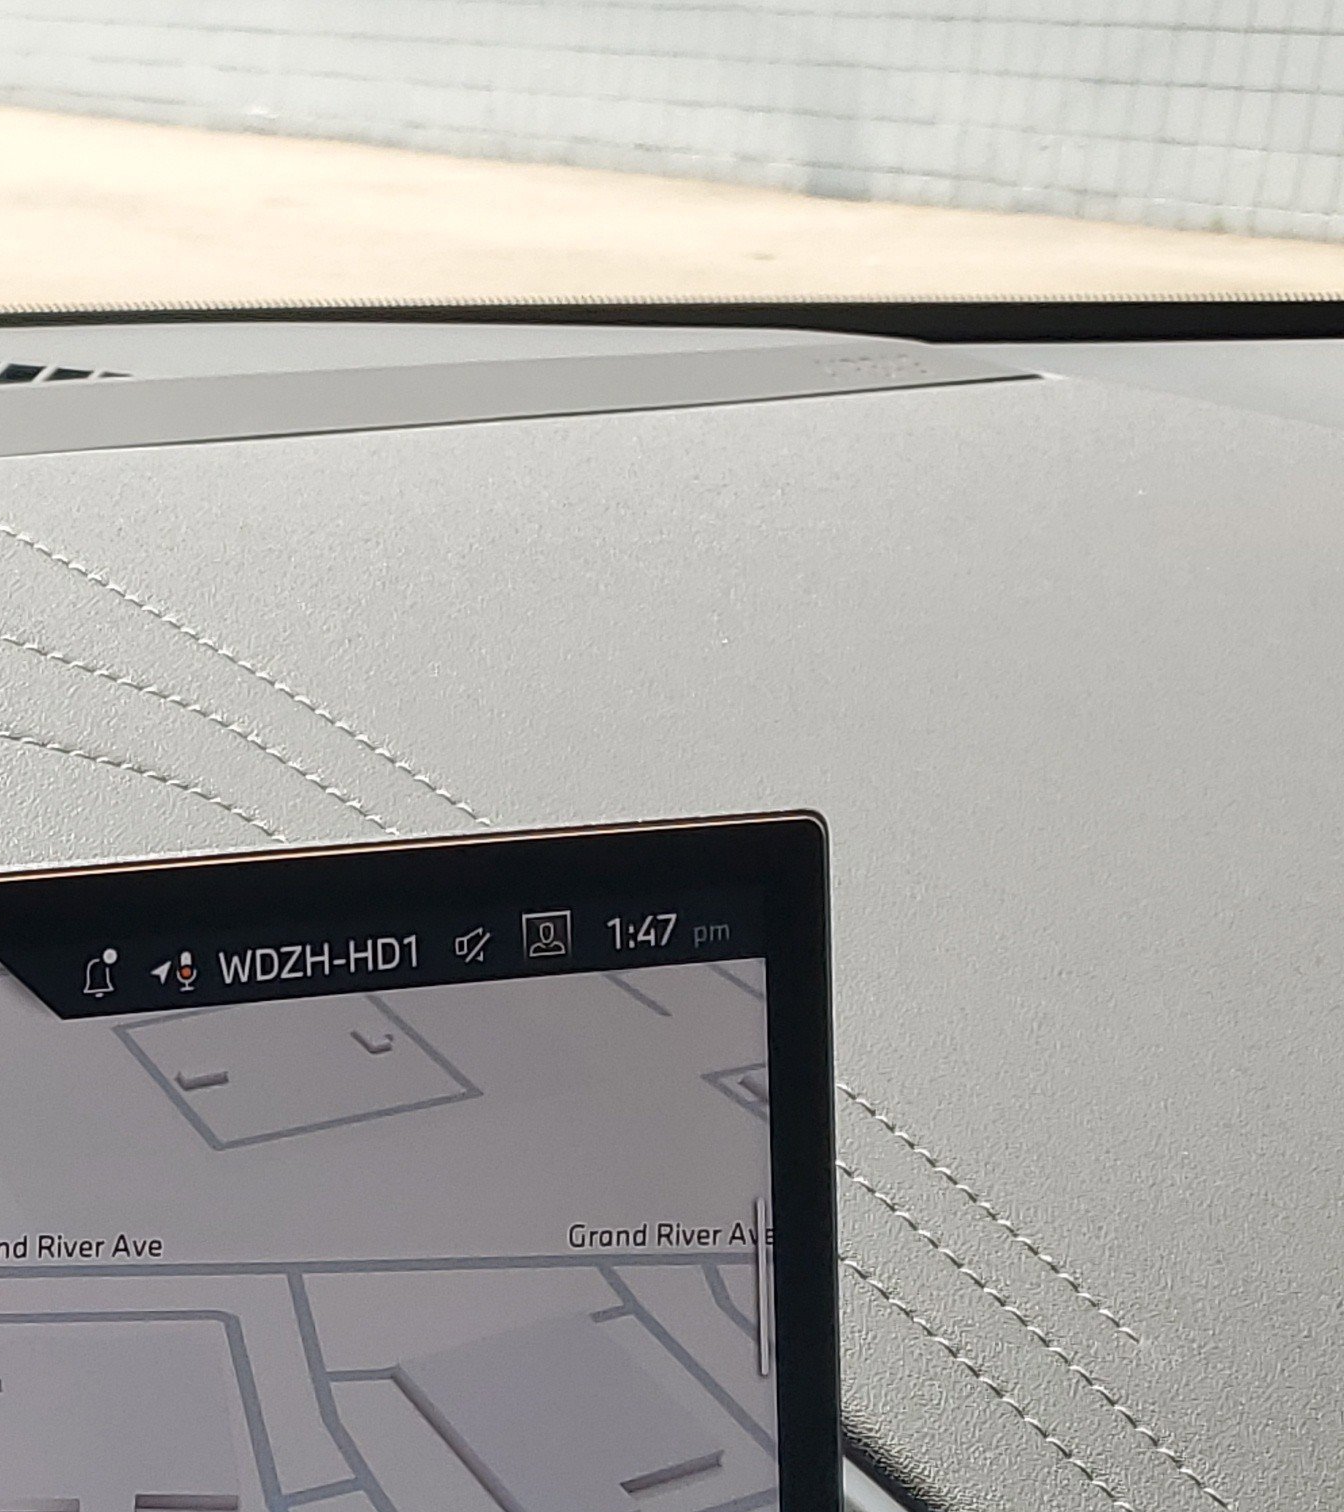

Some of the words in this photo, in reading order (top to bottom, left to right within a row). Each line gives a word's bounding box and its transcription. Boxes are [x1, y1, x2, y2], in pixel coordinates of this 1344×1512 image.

[607, 913, 679, 952] 1:47
[692, 925, 731, 948] pm
[219, 934, 420, 986] WDZH-HD1
[38, 1235, 105, 1258] River
[112, 1234, 163, 1258] Ave
[569, 1223, 648, 1248] Grand
[657, 1223, 722, 1247] River
